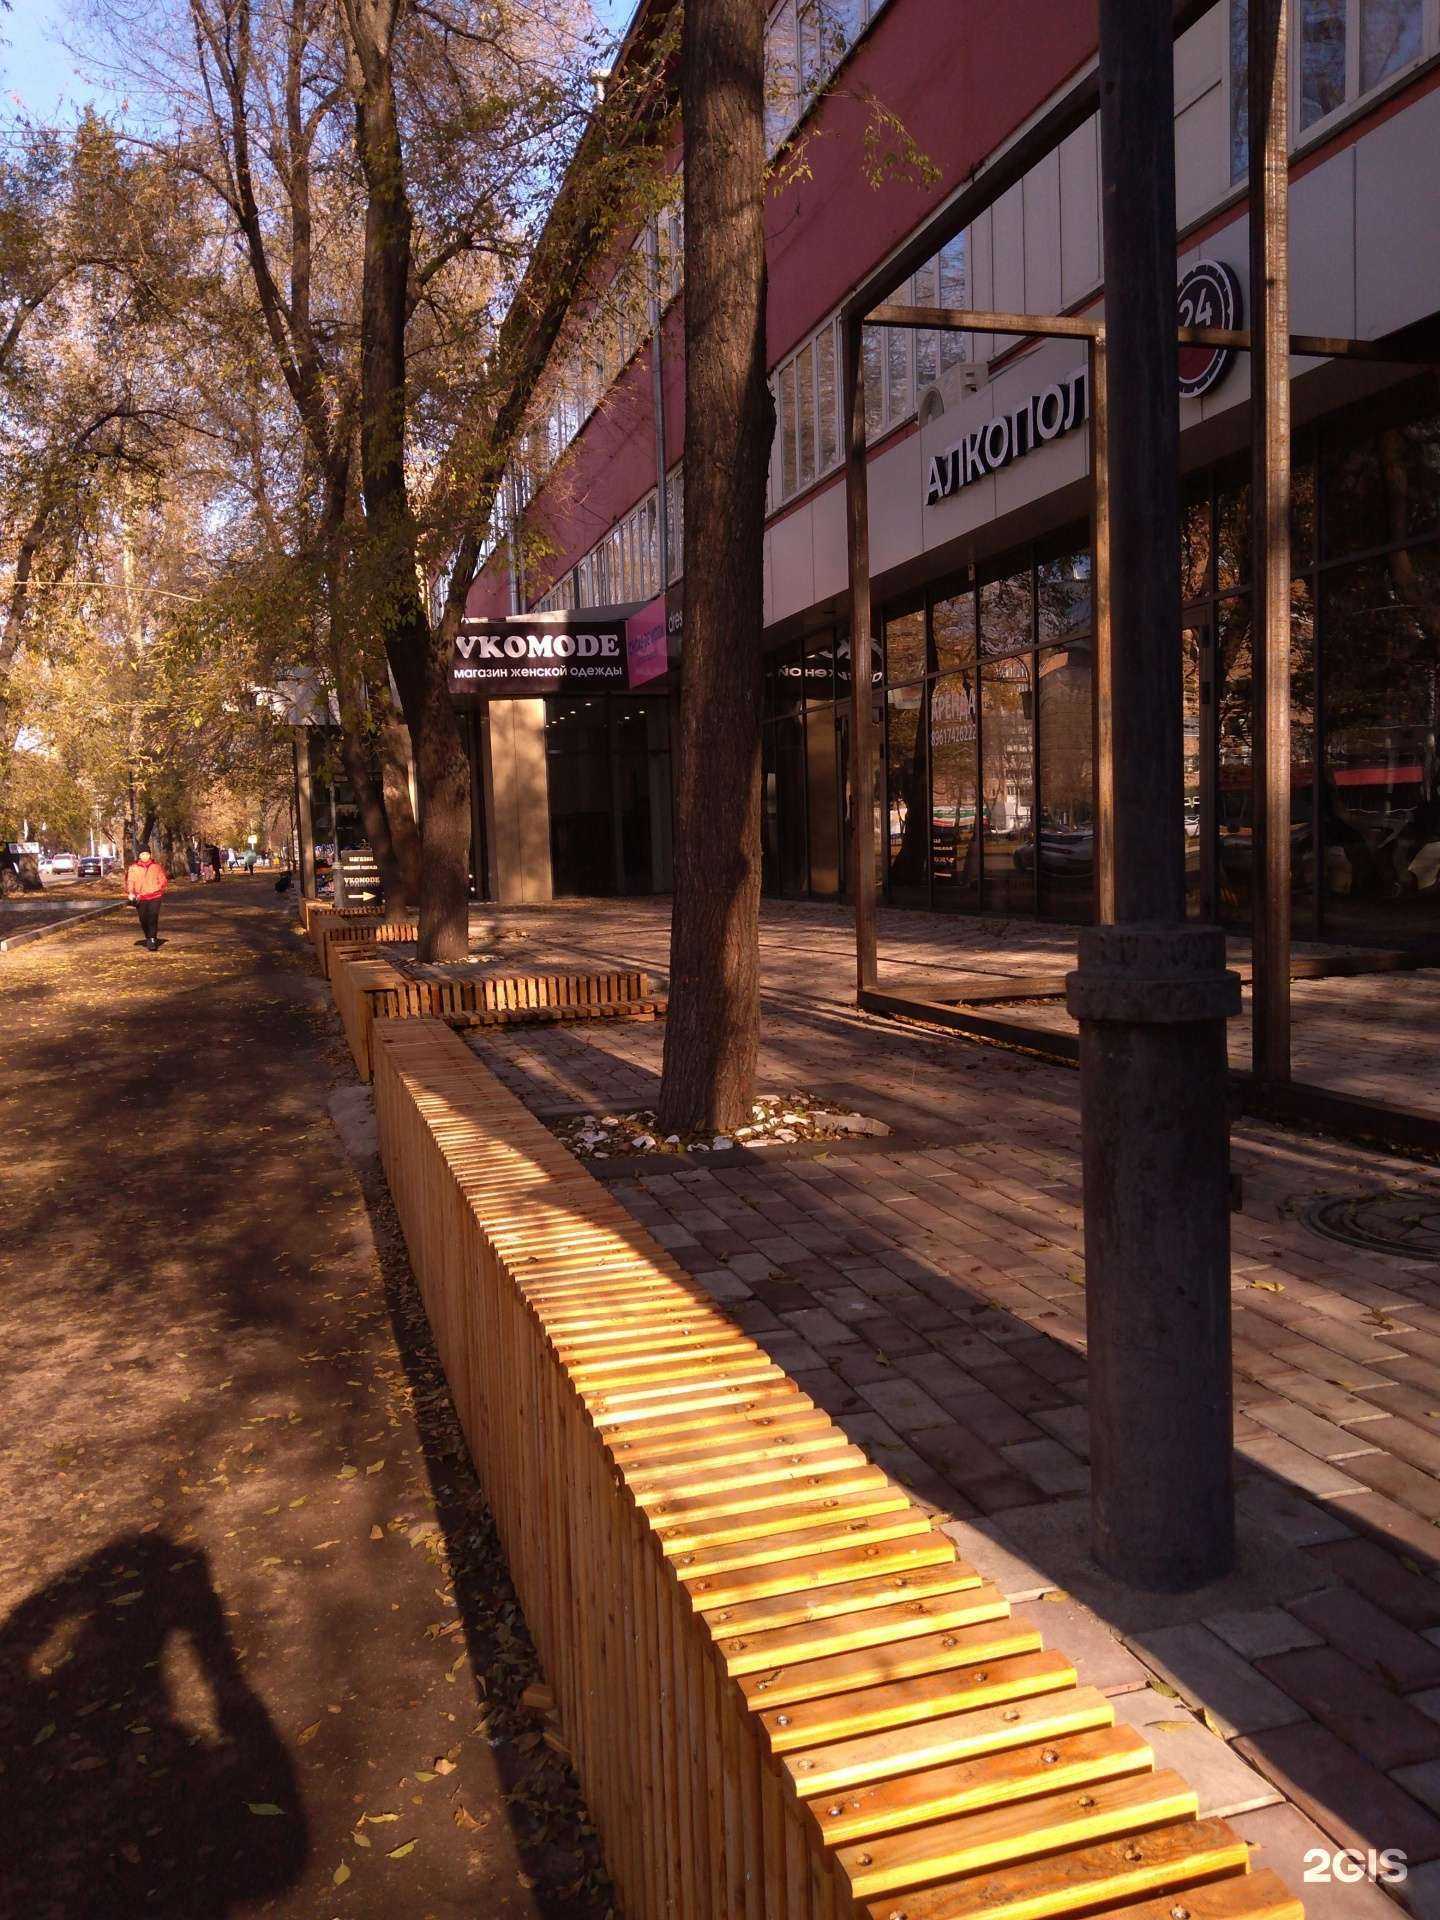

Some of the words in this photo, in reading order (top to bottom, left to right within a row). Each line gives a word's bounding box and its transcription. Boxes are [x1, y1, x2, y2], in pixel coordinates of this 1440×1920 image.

[455, 634, 620, 659] VKOMODE
[454, 668, 508, 679] магазин
[510, 664, 568, 677] женской
[570, 665, 623, 678] одежды
